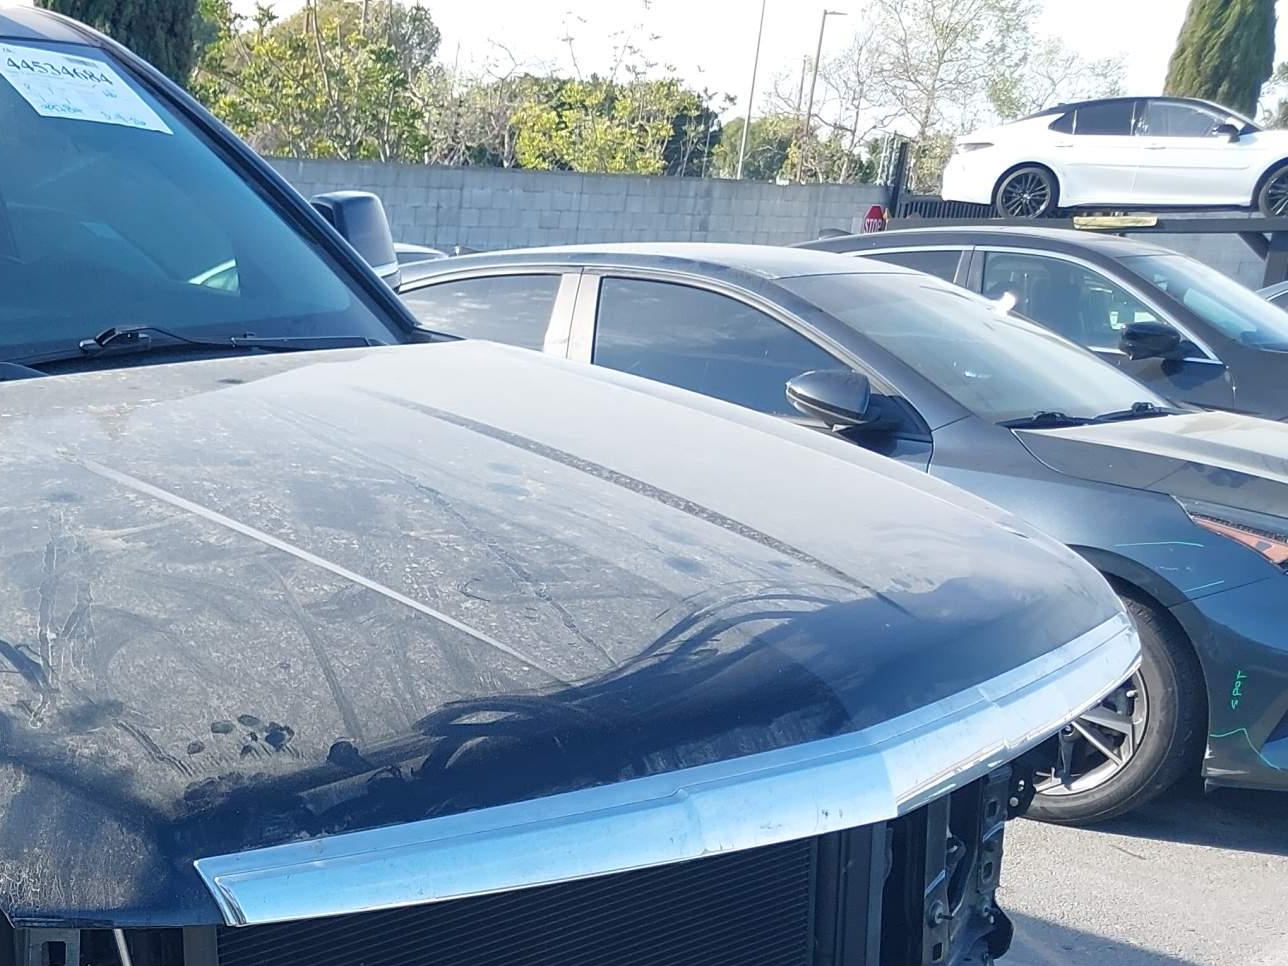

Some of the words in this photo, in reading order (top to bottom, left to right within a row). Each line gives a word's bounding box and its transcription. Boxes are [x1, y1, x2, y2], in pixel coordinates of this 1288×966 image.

[6, 56, 114, 86] 44534684
[864, 218, 883, 234] STOP
[1230, 670, 1248, 711] SPOT
